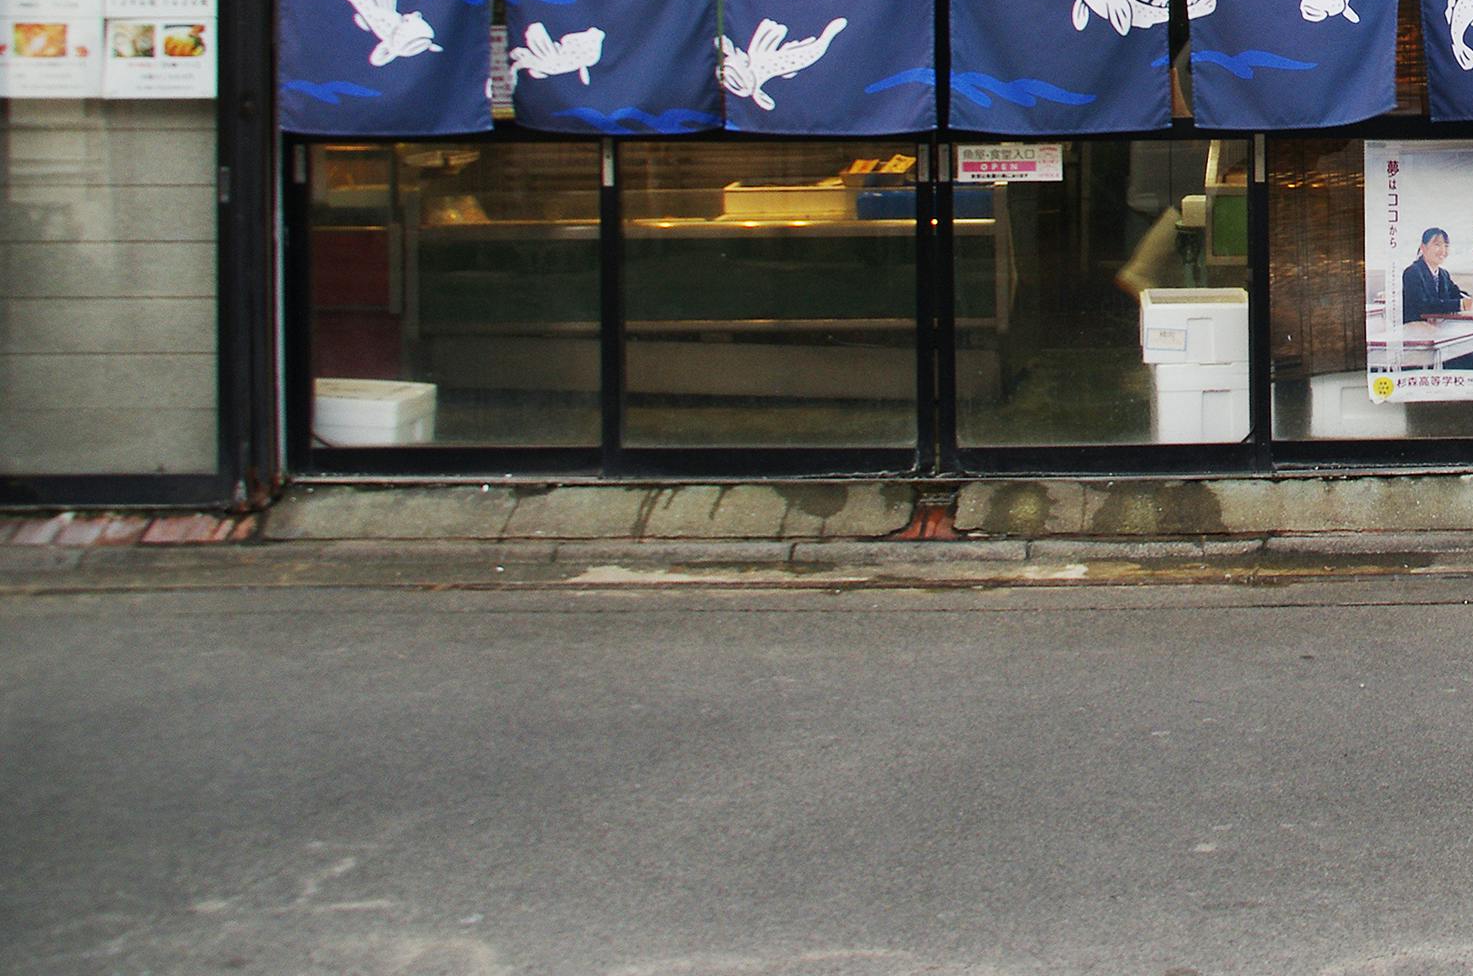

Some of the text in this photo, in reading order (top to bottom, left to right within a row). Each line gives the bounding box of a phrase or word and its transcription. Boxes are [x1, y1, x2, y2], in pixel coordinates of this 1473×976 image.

[980, 163, 1019, 171] OPEN
[1386, 160, 1399, 249] 夢はココから
